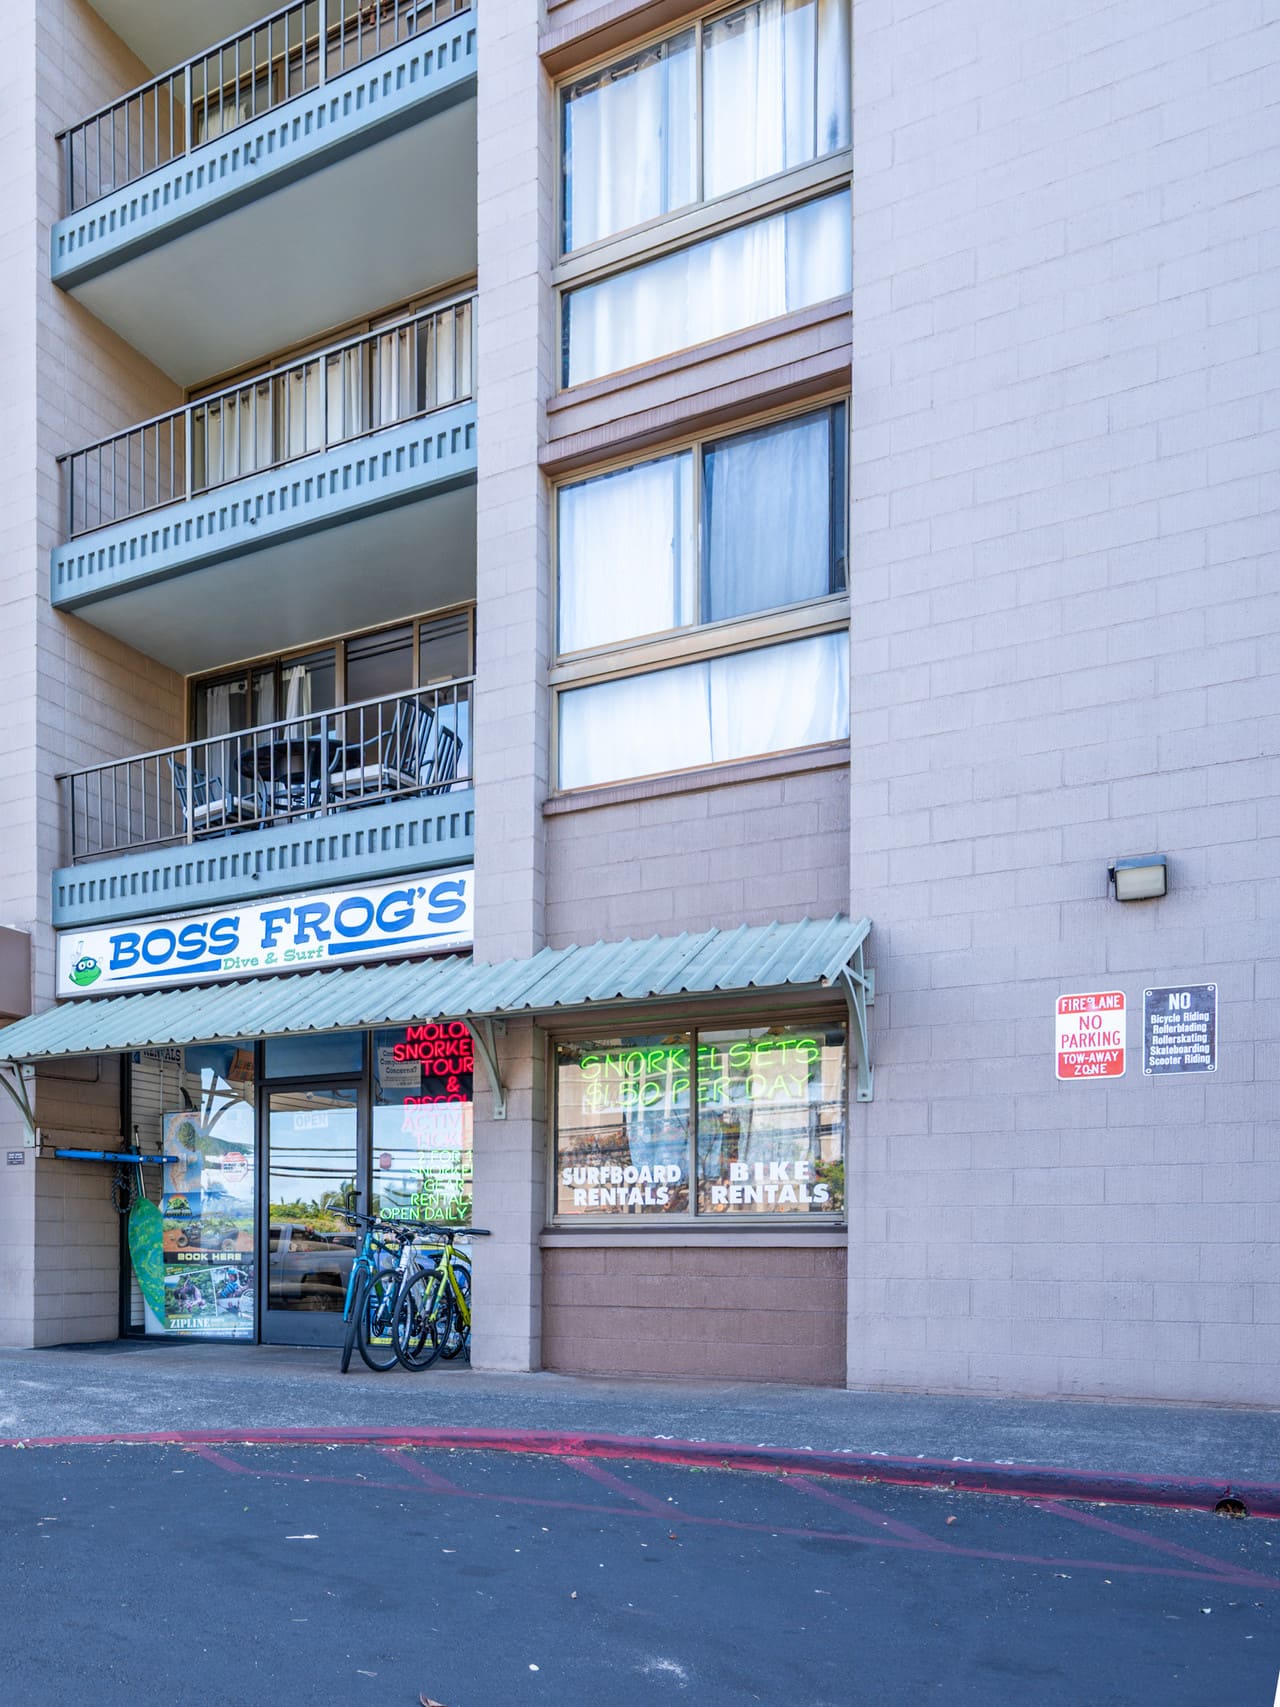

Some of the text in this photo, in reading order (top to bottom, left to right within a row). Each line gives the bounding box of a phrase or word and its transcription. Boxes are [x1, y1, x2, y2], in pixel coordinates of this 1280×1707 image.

[109, 879, 466, 970] BOSS FROG'S
[223, 945, 324, 970] Dive & Surf
[1061, 994, 1121, 1012] FIRE LANE
[1168, 992, 1191, 1010] NO
[1079, 1014, 1102, 1030] NO
[1150, 1011, 1209, 1025] Bicycle Riding
[1152, 1022, 1207, 1034] Rollerblading
[1061, 1031, 1120, 1049] PARKING
[1152, 1032, 1207, 1045] Rollerskating
[728, 1039, 819, 1068] SETS
[1062, 1050, 1119, 1065] TOW-AWAY
[1150, 1043, 1210, 1056] Skateboarding
[1149, 1054, 1210, 1066] Scooter Riding
[1074, 1063, 1107, 1076] ZONE
[446, 1075, 460, 1093] &
[745, 1072, 813, 1099] DAY
[295, 1112, 328, 1128] OPEN
[562, 1164, 681, 1186] SURFBOARD
[729, 1160, 810, 1182] BIKE
[423, 1178, 465, 1192] GEAR
[572, 1187, 669, 1206] RENTALS
[711, 1183, 830, 1205] RENTALS
[380, 1206, 468, 1220] OPEN DAILY
[177, 1252, 242, 1261] BOOK HERE
[170, 1319, 210, 1329] ZIPLINE
